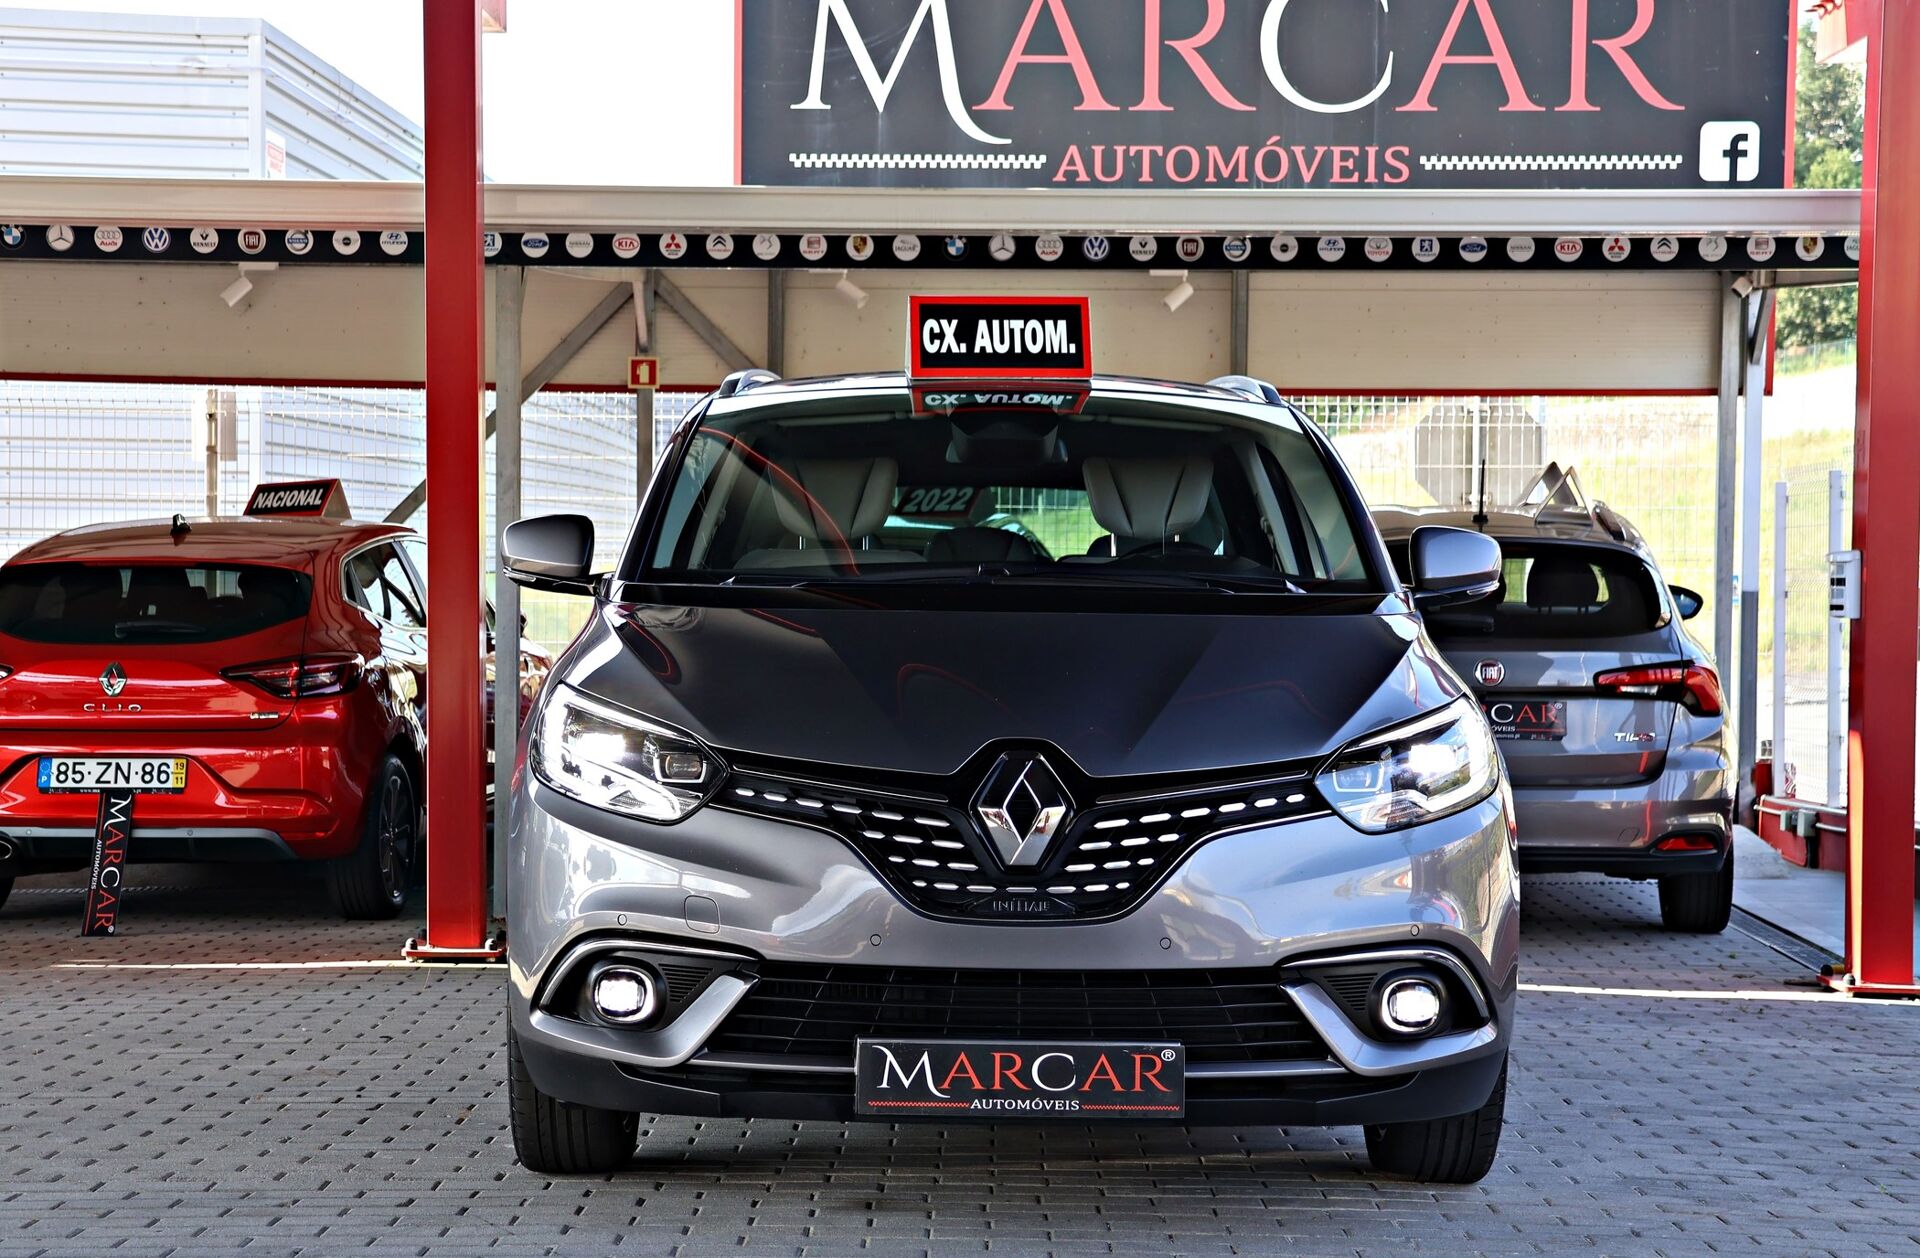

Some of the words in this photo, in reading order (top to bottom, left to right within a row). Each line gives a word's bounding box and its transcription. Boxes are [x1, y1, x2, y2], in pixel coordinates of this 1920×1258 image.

[790, 0, 1685, 145] MARCAR
[1052, 136, 1411, 184] AUTOMÓVEIS
[922, 319, 967, 354] CX.
[974, 319, 1076, 354] AUTOM.
[252, 488, 324, 510] NACIONAL
[902, 487, 974, 514] 2022
[1482, 666, 1500, 680] FIAT
[83, 703, 142, 712] CLIO
[174, 762, 186, 771] 19
[174, 776, 184, 785] 11
[970, 1097, 1080, 1111] AUTOMÓVEIS
